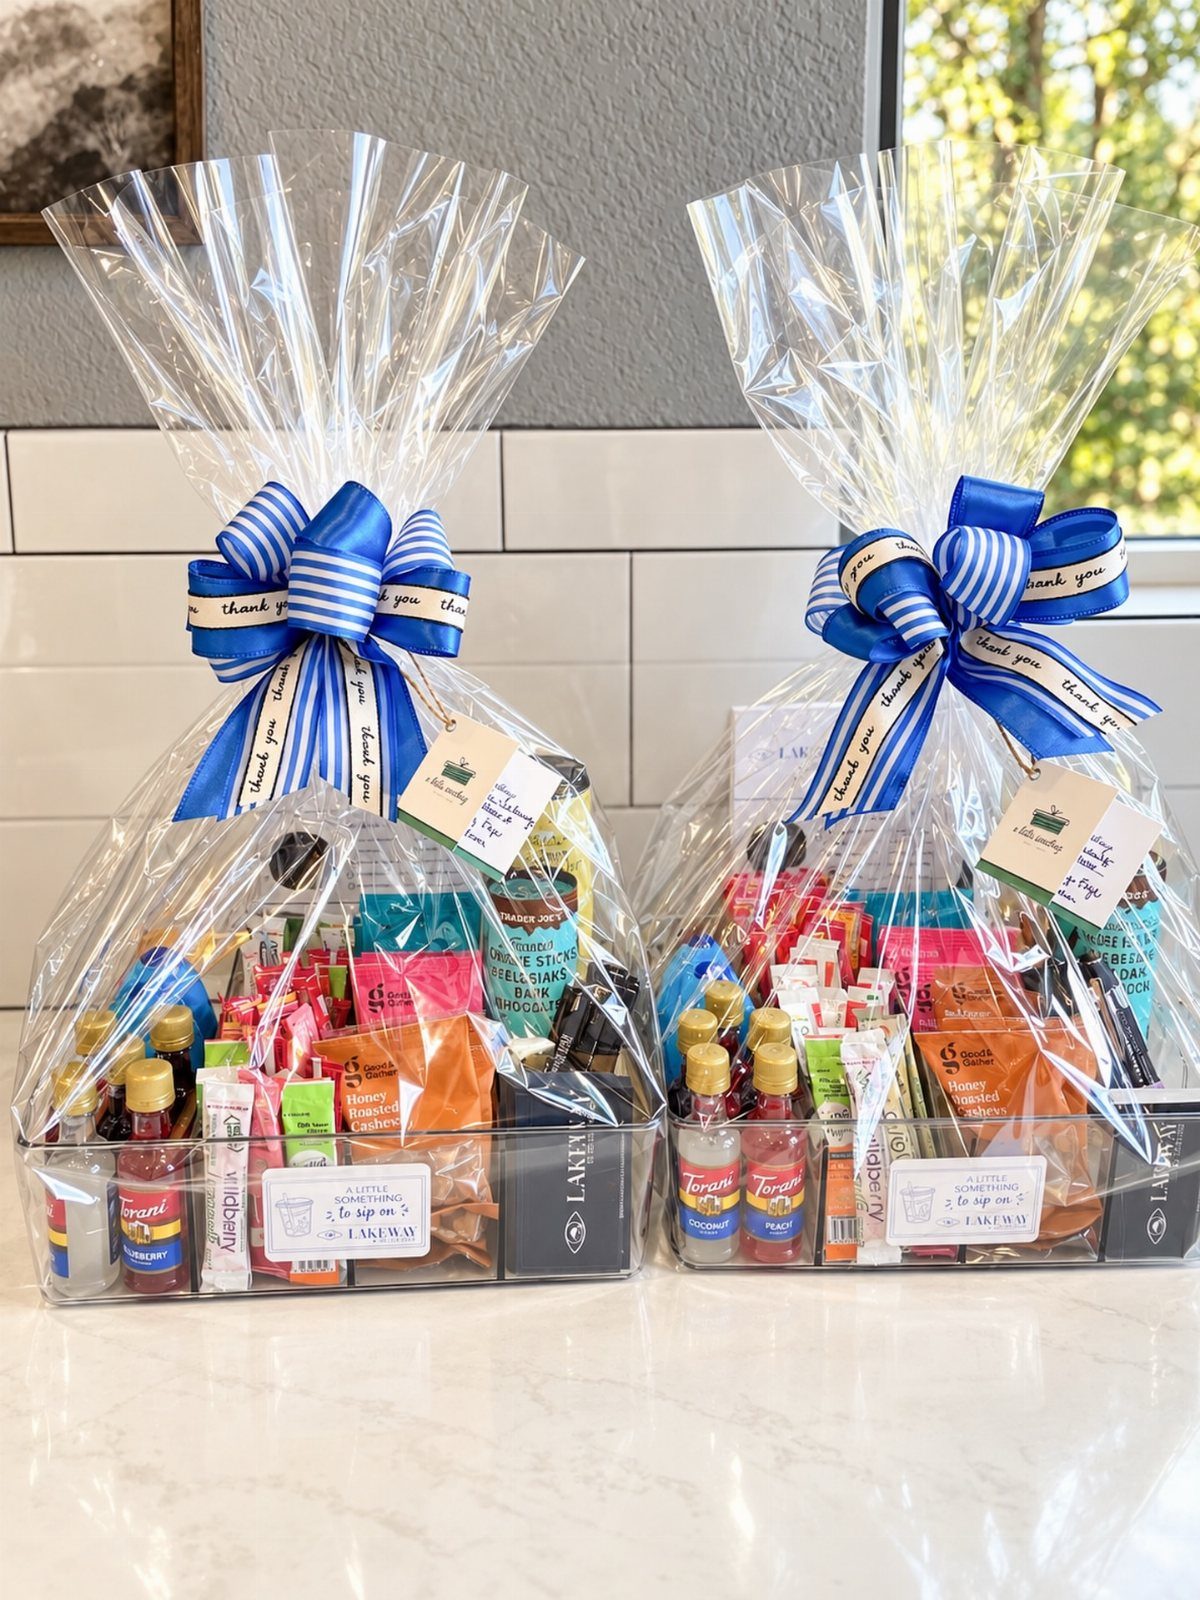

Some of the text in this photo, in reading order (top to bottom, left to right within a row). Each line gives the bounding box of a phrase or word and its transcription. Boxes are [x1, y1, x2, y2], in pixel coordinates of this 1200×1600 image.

[1075, 567, 1106, 588] you
[221, 598, 270, 615] thank
[276, 600, 288, 616] yo
[393, 595, 420, 609] you
[976, 635, 1010, 656] thank
[1012, 653, 1042, 670] you
[1061, 678, 1099, 713] thank
[350, 680, 366, 706] you
[834, 759, 859, 802] thank
[859, 726, 875, 755] you
[881, 669, 912, 708] thank
[250, 752, 269, 793] thank
[265, 718, 278, 745] you
[356, 774, 371, 803] you
[500, 912, 536, 923] TRADER
[948, 1080, 986, 1092] Honey
[347, 1092, 386, 1106] Honey
[350, 1102, 399, 1119] Roasted
[351, 1118, 401, 1133] Cashew
[682, 1171, 734, 1193] Torani
[751, 1169, 803, 1198] Torani
[976, 1174, 1008, 1183] LITTLE
[356, 1185, 389, 1194] LITTLE
[954, 1183, 1020, 1194] SOMETHING
[118, 1195, 169, 1219] Torani
[334, 1194, 403, 1205] SOMETHING
[957, 1195, 1012, 1209] to sip on
[339, 1206, 397, 1222] to sip on
[965, 1214, 1028, 1227] LAKEWAY
[688, 1219, 731, 1231] COCONUT
[349, 1226, 418, 1240] LAKEWAY
